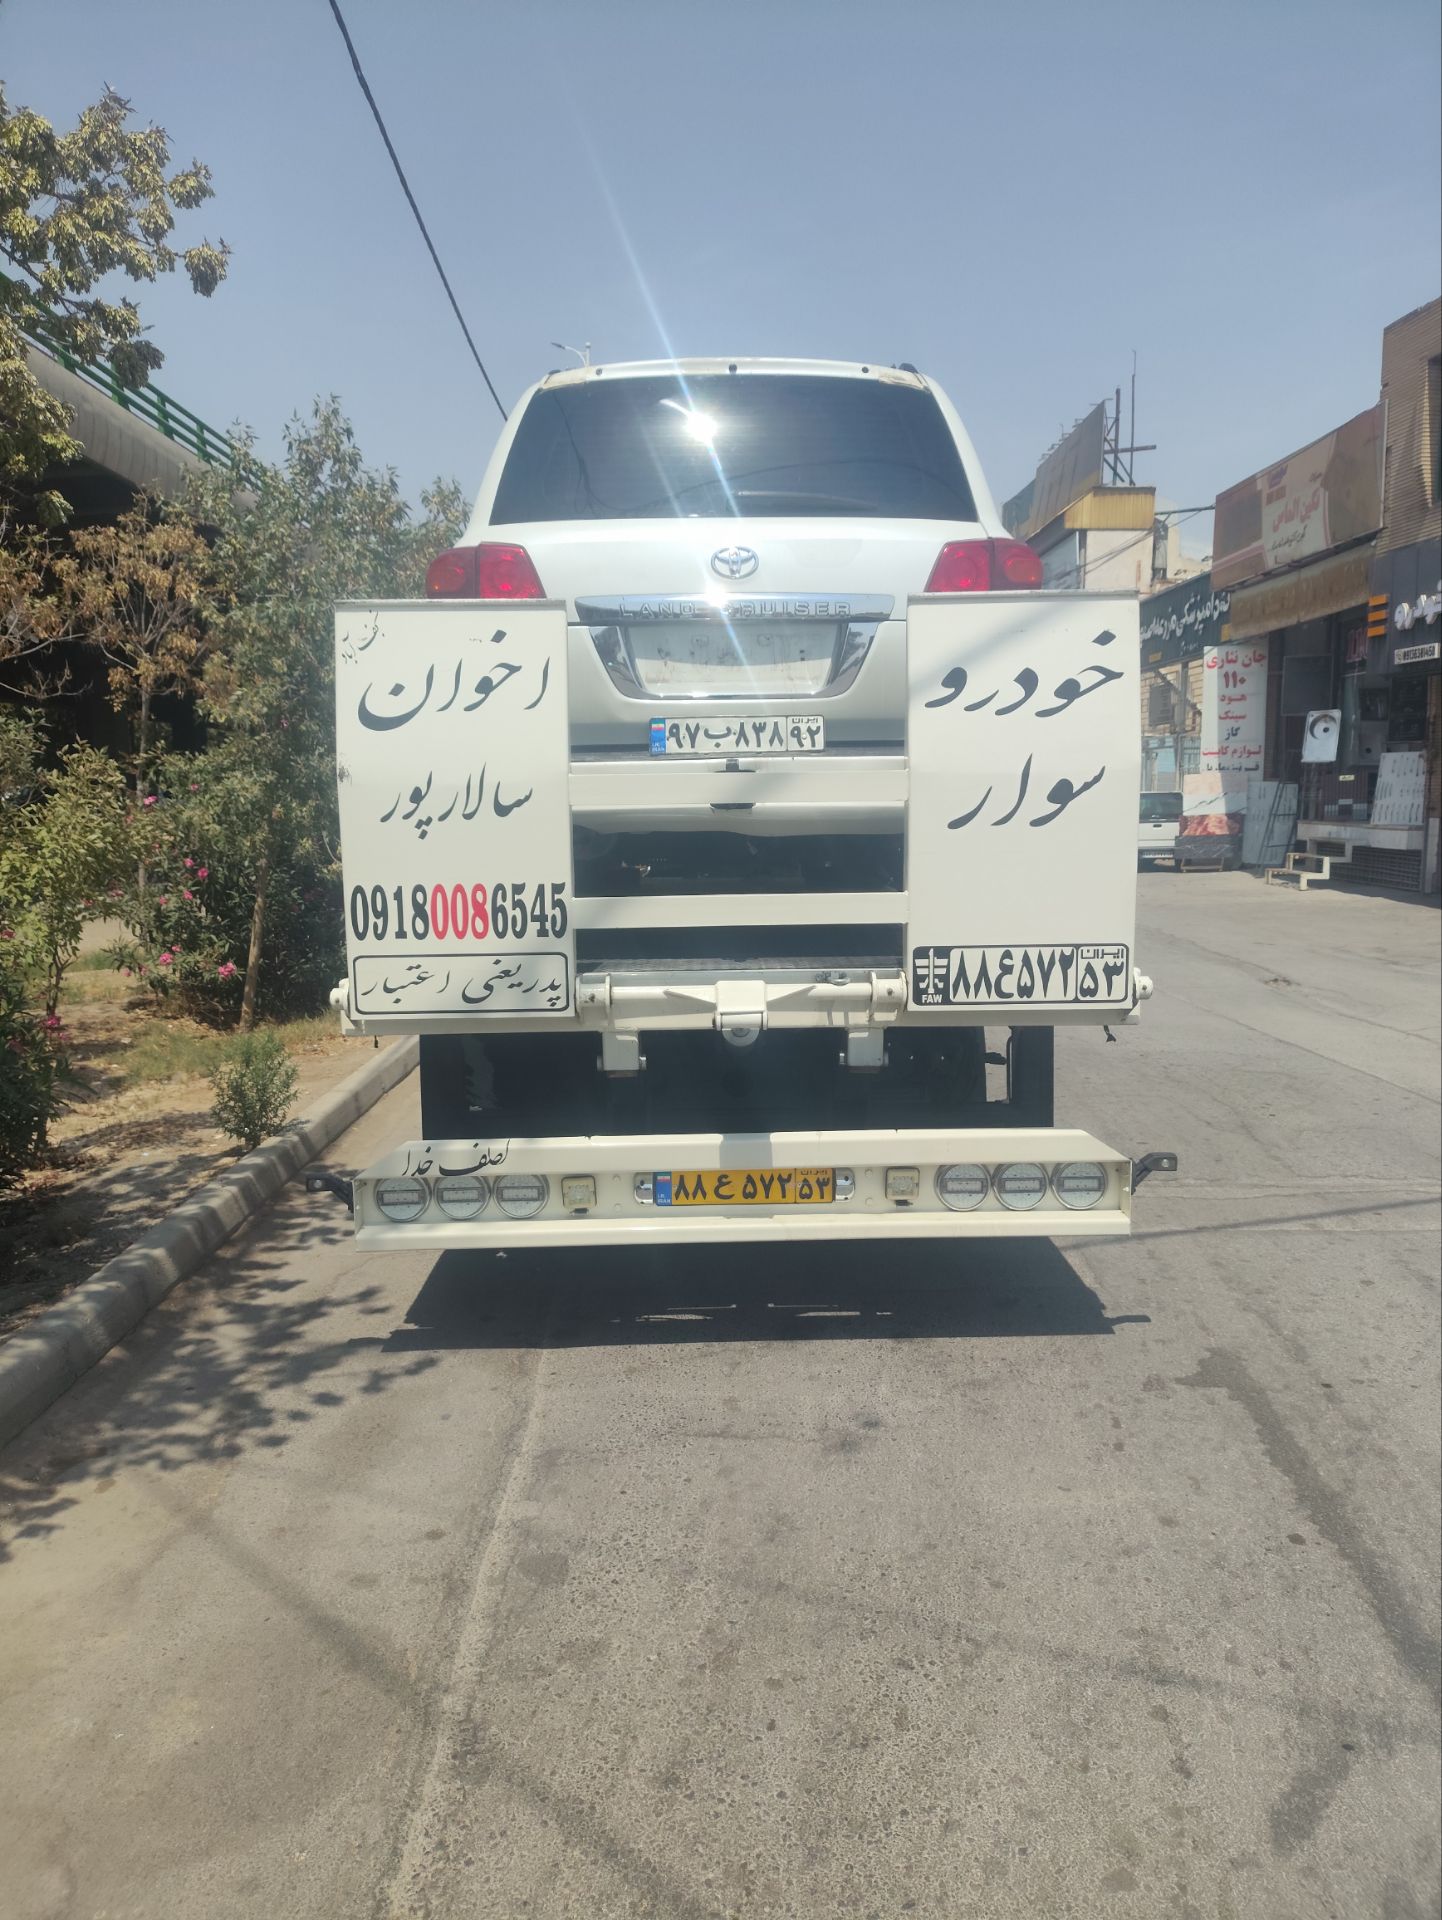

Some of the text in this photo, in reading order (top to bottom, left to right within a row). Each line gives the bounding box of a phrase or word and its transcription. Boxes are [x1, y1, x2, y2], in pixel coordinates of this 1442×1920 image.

[619, 602, 696, 618] LAND
[358, 629, 551, 731] اخوان
[924, 630, 1125, 717] خودرو
[947, 753, 1105, 829] سوار
[351, 882, 568, 941] 09180086545
[1081, 949, 1124, 960] ایران
[361, 959, 562, 1007] پدر یعنی اعتبار
[921, 994, 942, 1003] FAW
[402, 1146, 433, 1177] خدا
